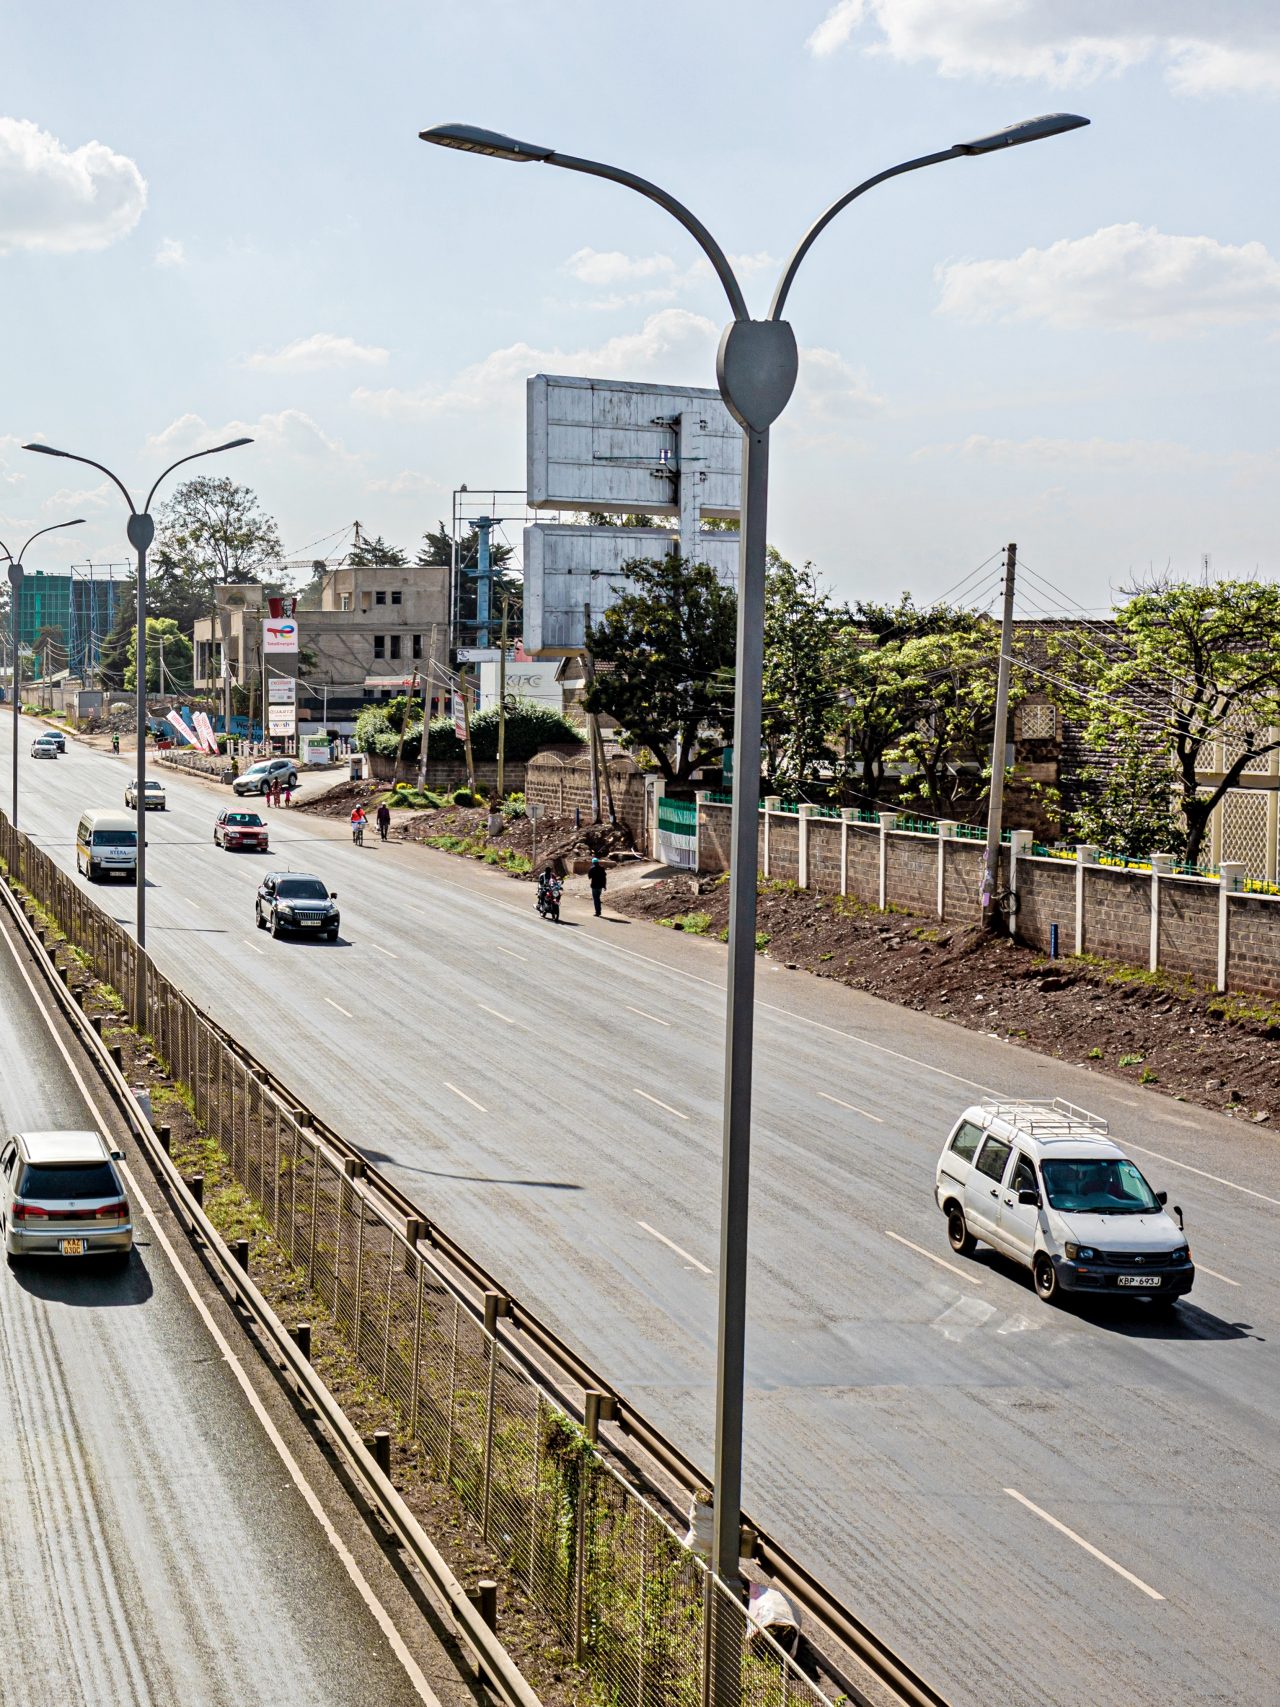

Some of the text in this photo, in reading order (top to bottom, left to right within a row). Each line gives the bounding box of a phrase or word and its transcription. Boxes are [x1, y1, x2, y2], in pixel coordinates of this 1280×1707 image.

[505, 674, 543, 688] KFC
[67, 1239, 81, 1247] KAZ
[1118, 1277, 1160, 1286] KBP 693J
